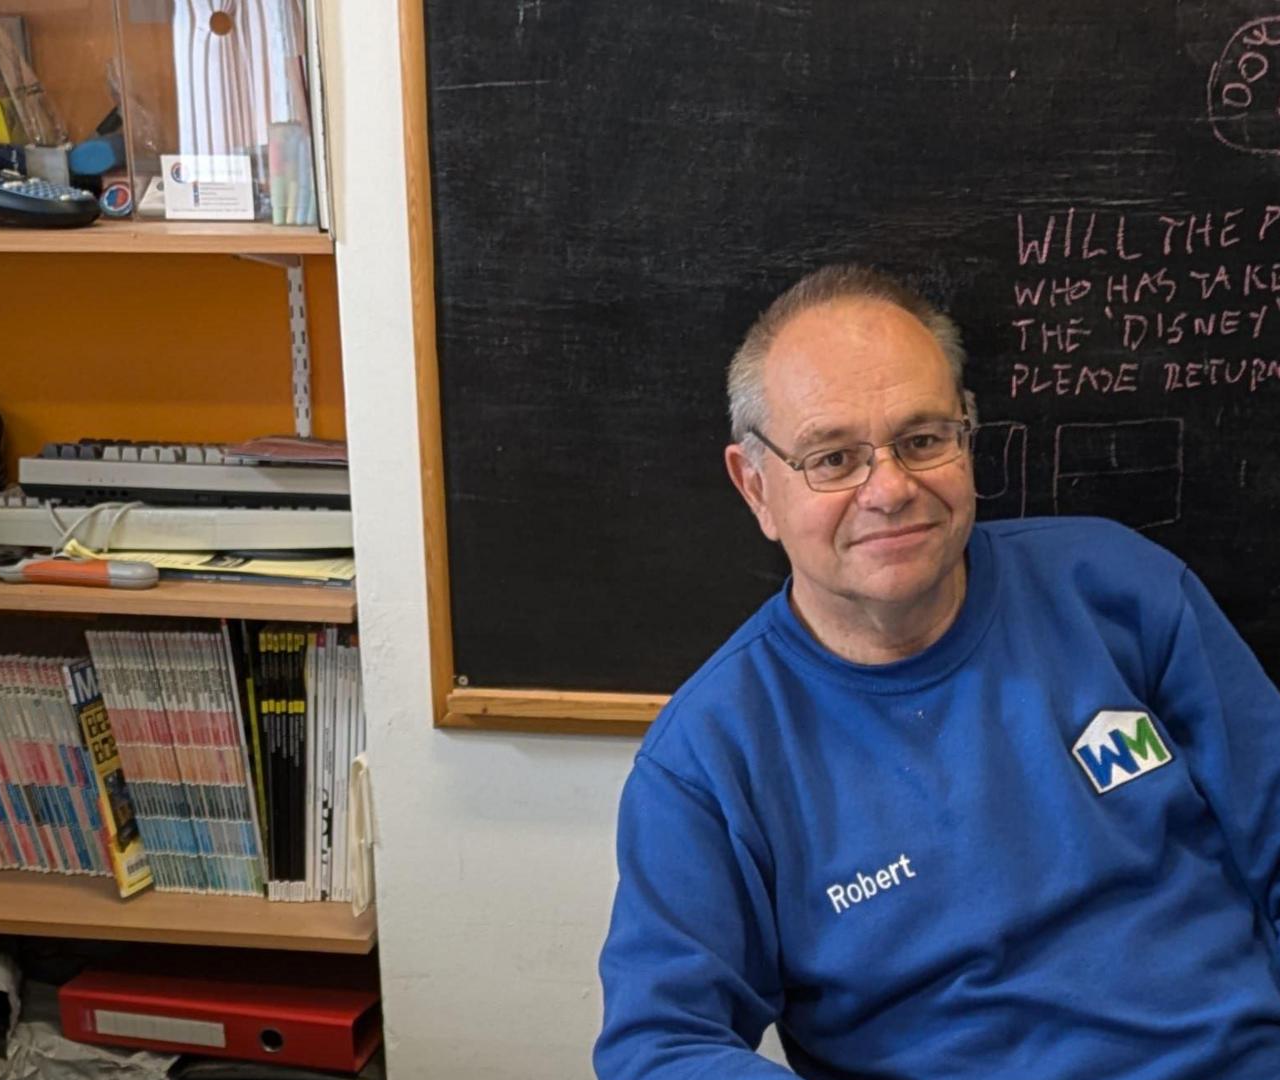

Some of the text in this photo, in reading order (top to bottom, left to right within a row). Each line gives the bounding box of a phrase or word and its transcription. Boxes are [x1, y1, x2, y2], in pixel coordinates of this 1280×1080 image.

[1019, 208, 1142, 265] WILL
[1160, 208, 1244, 256] THE
[1014, 278, 1092, 307] WHO
[1107, 267, 1177, 303] HAS
[1012, 317, 1092, 354] THE
[1011, 363, 1140, 399] PLEASE
[826, 853, 916, 914] Robert
